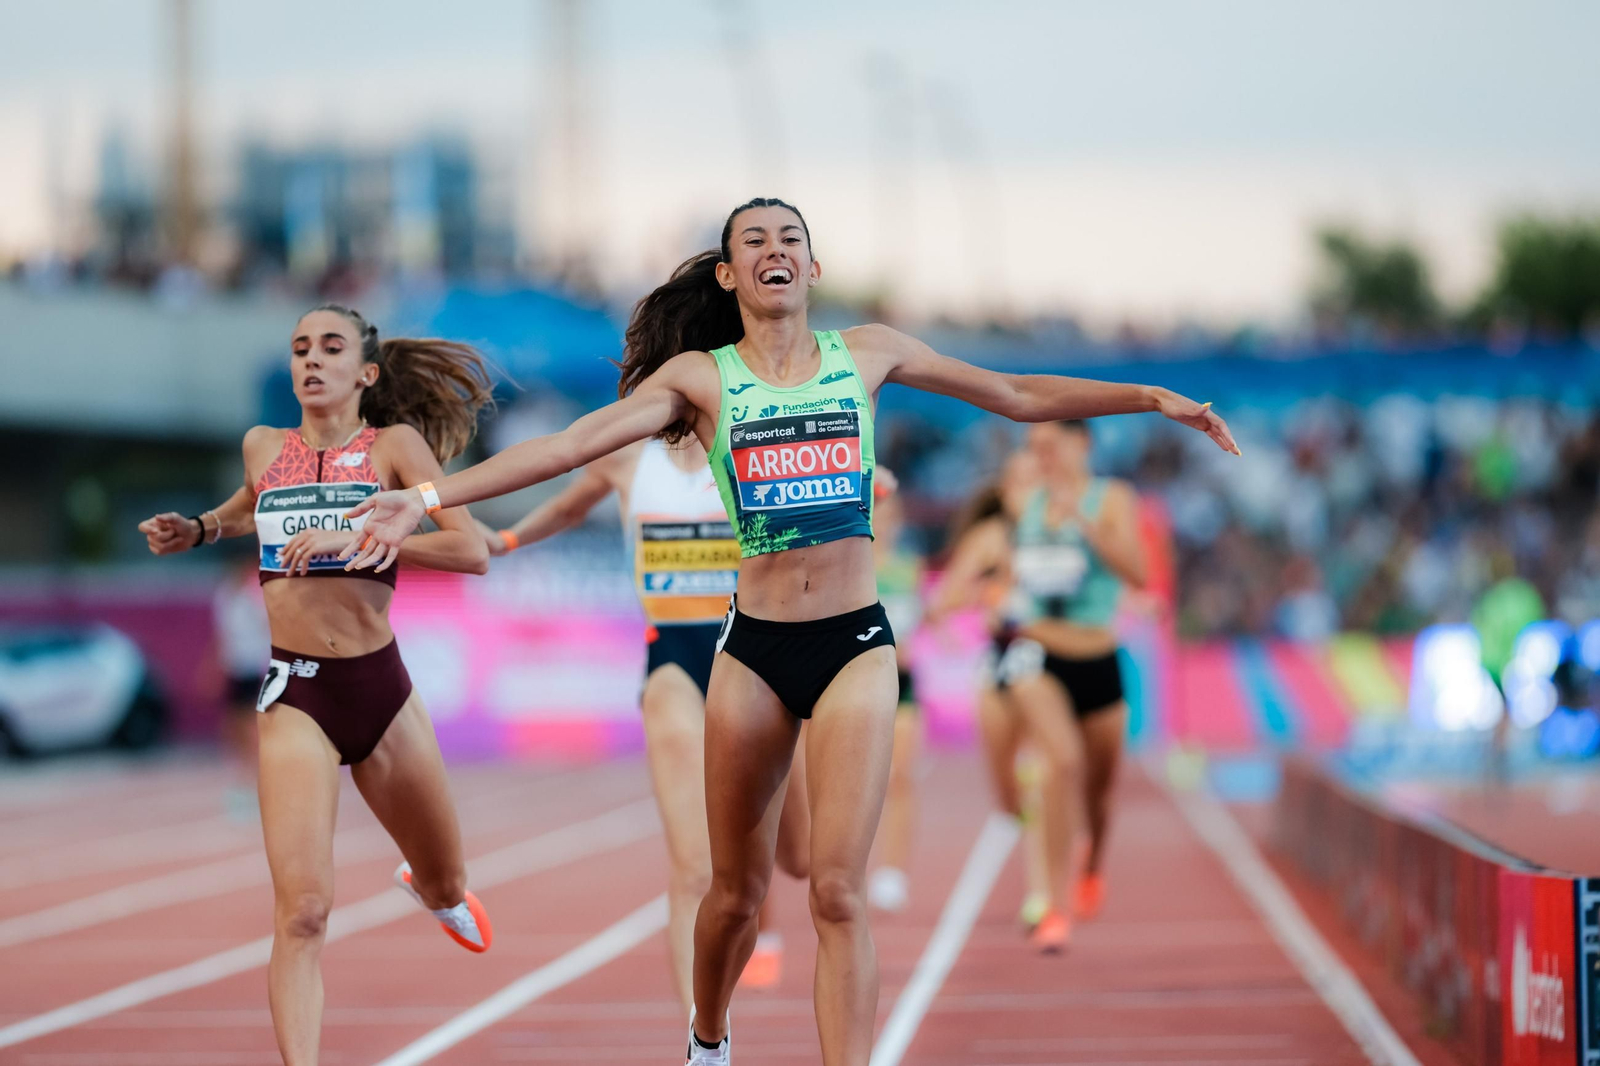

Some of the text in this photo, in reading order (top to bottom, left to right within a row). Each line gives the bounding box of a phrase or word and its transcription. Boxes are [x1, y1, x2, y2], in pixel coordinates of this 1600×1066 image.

[782, 397, 837, 411] Fundación
[817, 418, 849, 427] Generalitat
[825, 424, 854, 433] Catalunya
[745, 426, 796, 442] esportcat
[747, 441, 851, 478] ARROYO
[272, 494, 317, 507] esportcat
[283, 514, 353, 536] GARCIA
